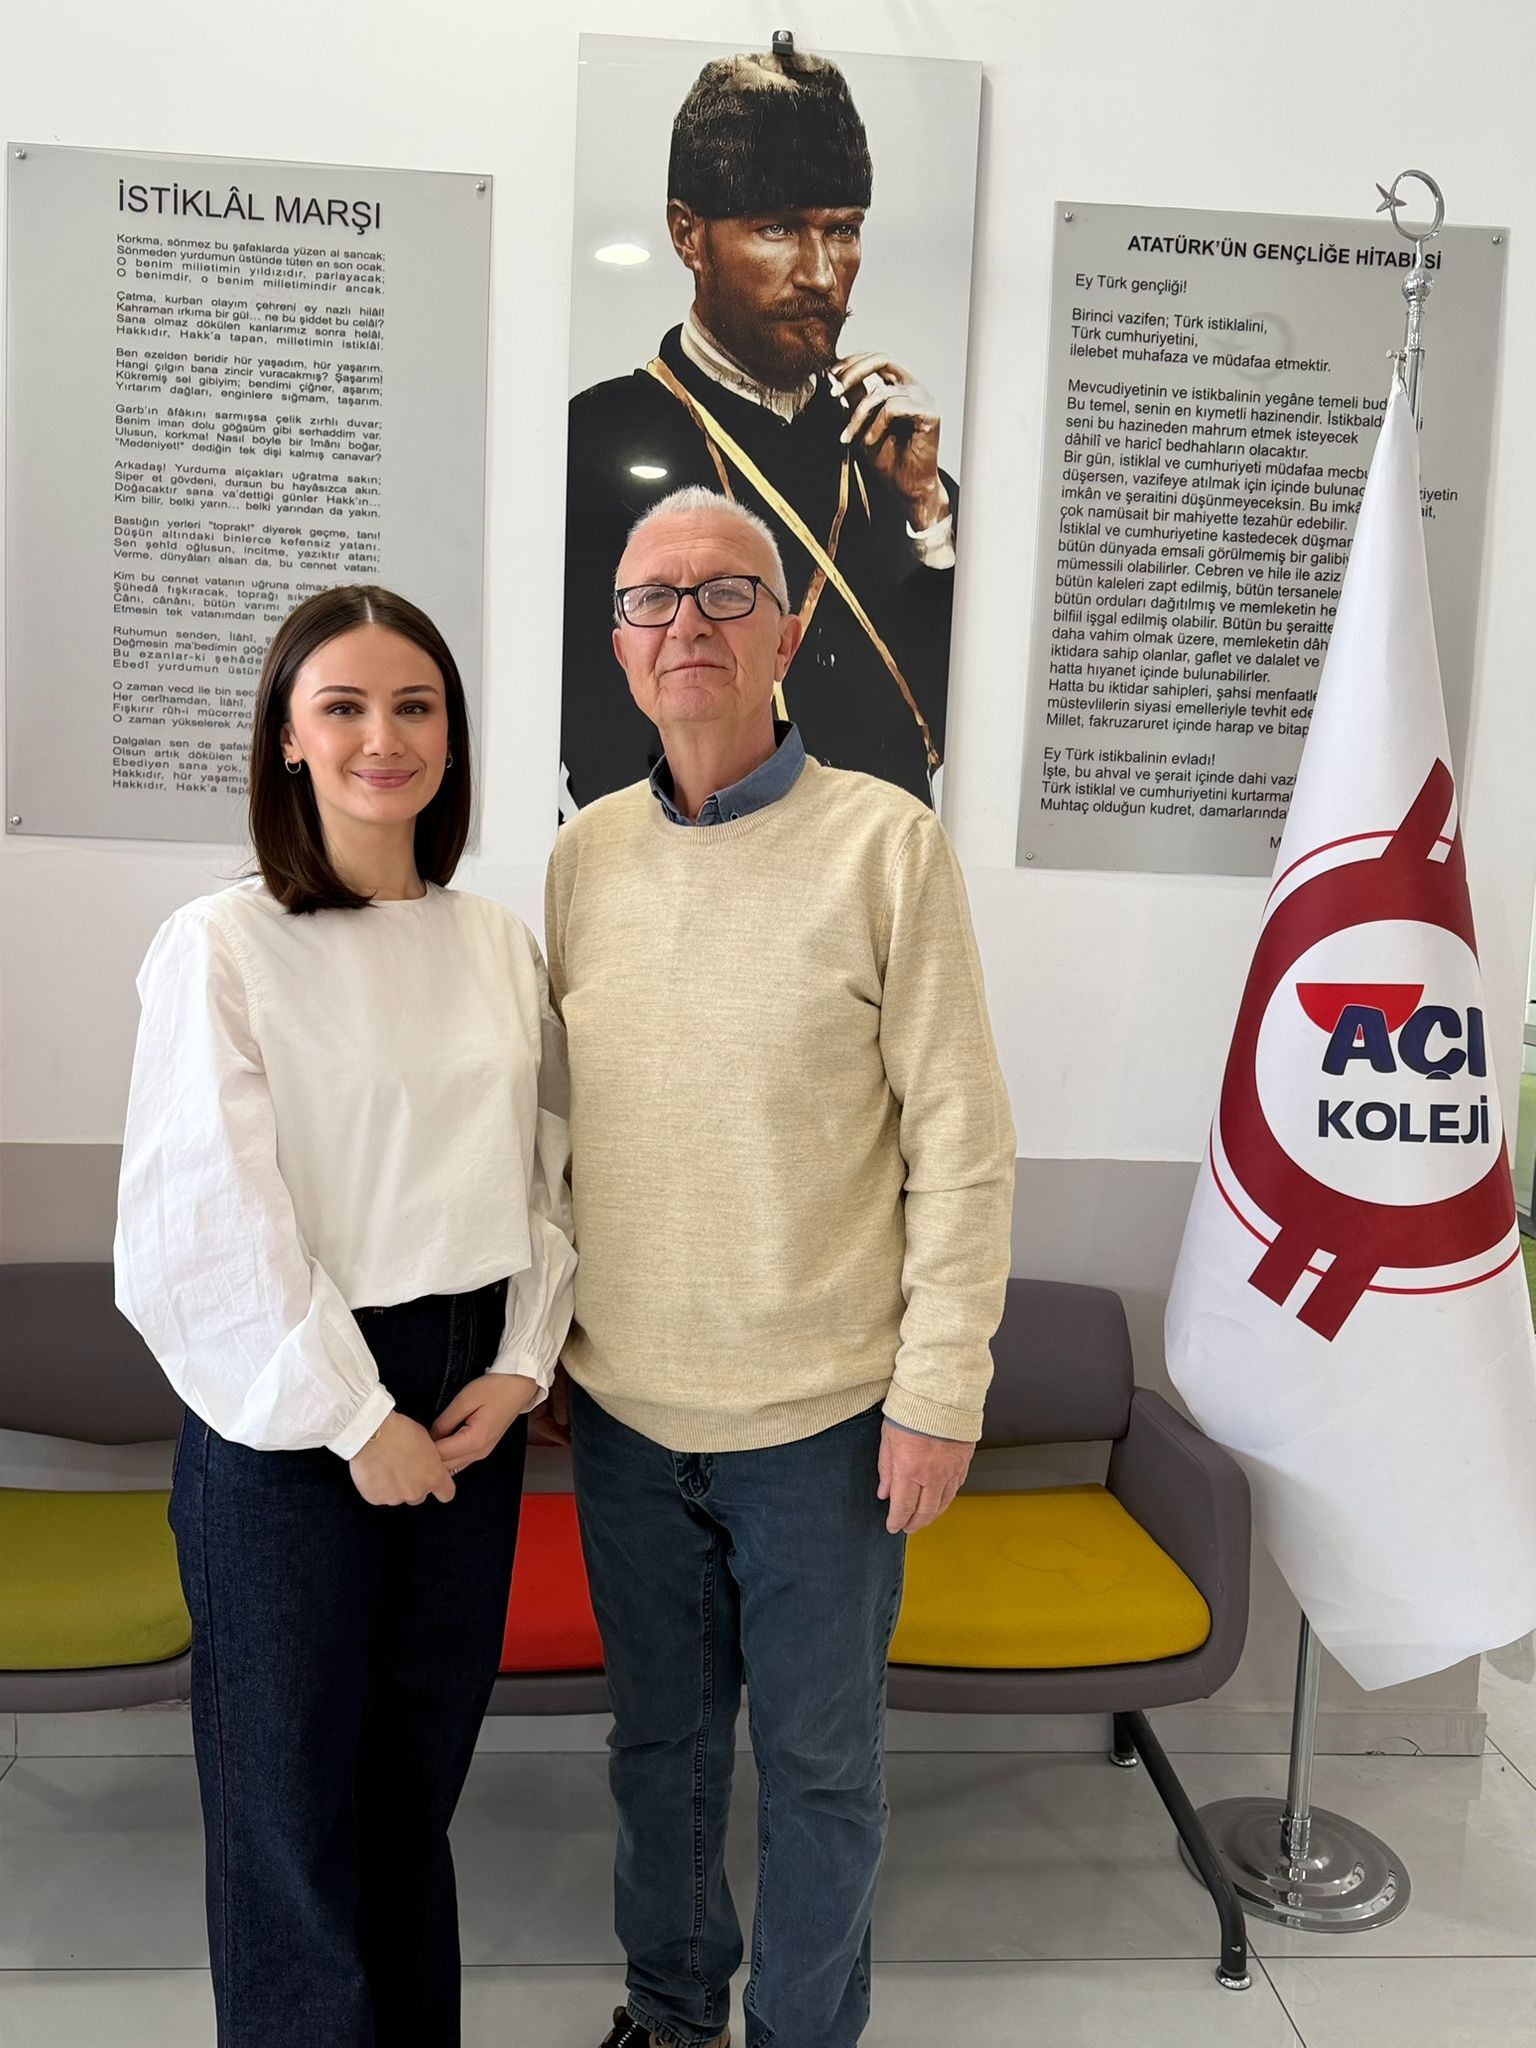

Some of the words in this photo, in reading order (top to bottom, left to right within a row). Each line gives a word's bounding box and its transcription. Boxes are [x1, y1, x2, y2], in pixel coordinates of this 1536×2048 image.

[118, 179, 265, 221] İSTİKLÂL
[275, 195, 380, 235] MARŞI
[116, 245, 177, 258] Sönmeden
[179, 251, 235, 262] yurdumun
[238, 253, 283, 265] üstünde
[285, 257, 313, 267] tüten
[315, 260, 330, 268] en
[332, 261, 353, 270] son
[166, 237, 211, 249] sönmez
[214, 240, 228, 250] bu
[232, 242, 289, 254] şafaklarda
[292, 245, 326, 257] yüzen
[329, 248, 340, 257] al
[1253, 242, 1350, 265] GENÇLİĞE
[116, 256, 127, 266] O
[135, 258, 175, 269] benim
[181, 261, 240, 274] milletimin
[116, 268, 126, 278] O
[200, 275, 208, 283] o
[216, 274, 254, 286] benim
[262, 278, 337, 291] milletimindir
[1075, 273, 1093, 291] Ey
[1097, 275, 1127, 290] Türk
[1130, 278, 1187, 296] gençliği!
[1071, 308, 1113, 323] Birinci
[1117, 312, 1170, 329] vazifen;
[1171, 314, 1203, 329] Türk
[1207, 316, 1268, 335] istiklalini,
[1072, 326, 1101, 340] Türk
[1104, 329, 1198, 348] cumhuriyetini,
[1069, 343, 1118, 359] ilelebet
[1121, 347, 1188, 363] muhafaza
[1192, 353, 1208, 364] ve
[1212, 352, 1270, 368] müdafaa
[1274, 356, 1331, 372] etmektir.
[115, 359, 148, 372] Hangi
[154, 362, 184, 374] çılgın
[190, 363, 218, 374] bana
[223, 366, 254, 376] zincir
[258, 369, 329, 383] vuracakmış?
[334, 372, 383, 384] Şaşarım!
[115, 381, 161, 393] Yırtarım
[220, 389, 273, 400] enginlere
[1067, 379, 1167, 399] Mevcudiyetinin
[1171, 388, 1188, 399] ve
[1191, 386, 1261, 403] istikbalinin
[1264, 392, 1314, 408] yegâne
[1317, 394, 1358, 409] temeli
[1065, 416, 1093, 429] seni
[1097, 416, 1114, 430] bu
[1118, 417, 1188, 434] hazineden
[1191, 422, 1247, 438] mahrum
[1250, 426, 1292, 440] etmek
[1295, 427, 1358, 446] isteyecek
[191, 442, 231, 455] dediğin
[238, 445, 256, 455] tek
[262, 446, 282, 458] dişi
[288, 447, 325, 461] kalmış
[331, 452, 382, 462] canavar?
[1064, 432, 1102, 447] dâhilî
[1104, 437, 1121, 448] ve
[1124, 435, 1162, 451] haricî
[1165, 438, 1245, 455] bedhahların
[1248, 442, 1309, 458] olacaktır.
[1061, 485, 1101, 500] imkân
[1105, 490, 1121, 501] ve
[1125, 490, 1177, 505] şeraitini
[1180, 491, 1305, 511] düşünmeyeceksin.
[1309, 498, 1328, 512] Bu
[1059, 504, 1084, 520] çok
[1087, 505, 1149, 521] namüsait
[1152, 508, 1170, 522] bir
[1173, 509, 1239, 527] mahiyette
[1242, 513, 1293, 528] tezahür
[1296, 515, 1348, 531] edebilir.
[217, 555, 247, 565] alsan
[279, 558, 293, 568] bu
[299, 561, 337, 570] cennet
[1056, 556, 1123, 572] mümessili
[1126, 559, 1190, 575] olabilirler.
[1194, 562, 1244, 578] Cebren
[1247, 568, 1264, 579] ve
[1267, 566, 1291, 580] hile
[1294, 567, 1310, 581] ile
[1313, 569, 1341, 582] aziz
[113, 626, 167, 638] Ruhumun
[1053, 608, 1082, 623] bilfiil
[1086, 610, 1117, 627] işgal
[1120, 612, 1168, 630] edilmiş
[1171, 614, 1218, 629] olabilir.
[1222, 616, 1262, 631] Bütün
[1265, 618, 1282, 632] bu
[1050, 643, 1099, 658] iktidara
[1102, 646, 1139, 663] sahip
[1142, 647, 1191, 665] olanlar,
[1194, 650, 1232, 666] gaflet
[1235, 654, 1252, 665] ve
[1255, 652, 1300, 667] dalalet
[1303, 657, 1320, 668] ve
[1049, 660, 1083, 675] hatta
[1086, 662, 1136, 679] hıyanet
[1139, 664, 1179, 681] içinde
[1182, 666, 1271, 683] bulunabilirler.
[1046, 712, 1085, 729] Millet,
[1088, 714, 1169, 730] fakruzaruret
[1172, 717, 1211, 734] içinde
[1215, 719, 1254, 737] harap
[1257, 724, 1274, 734] ve
[112, 757, 169, 770] Ebediyen
[178, 762, 208, 770] sana
[1043, 746, 1062, 763] Ey
[1063, 747, 1095, 761] Türk
[1098, 748, 1167, 764] istikbalinin
[1170, 752, 1215, 766] evladı!
[172, 770, 192, 780] hür
[1042, 761, 1071, 780] İşte,
[1074, 764, 1091, 778] bu
[1094, 765, 1131, 780] ahval
[1134, 770, 1151, 780] ve
[1154, 768, 1192, 784] şerait
[1195, 769, 1234, 786] içinde
[1237, 771, 1266, 785] dahi
[1040, 797, 1089, 816] Muhtaç
[1092, 799, 1145, 817] olduğun
[1149, 801, 1195, 818] kudret,
[1321, 1004, 1487, 1080] AÇI
[1318, 1095, 1489, 1144] KOLEJİ
